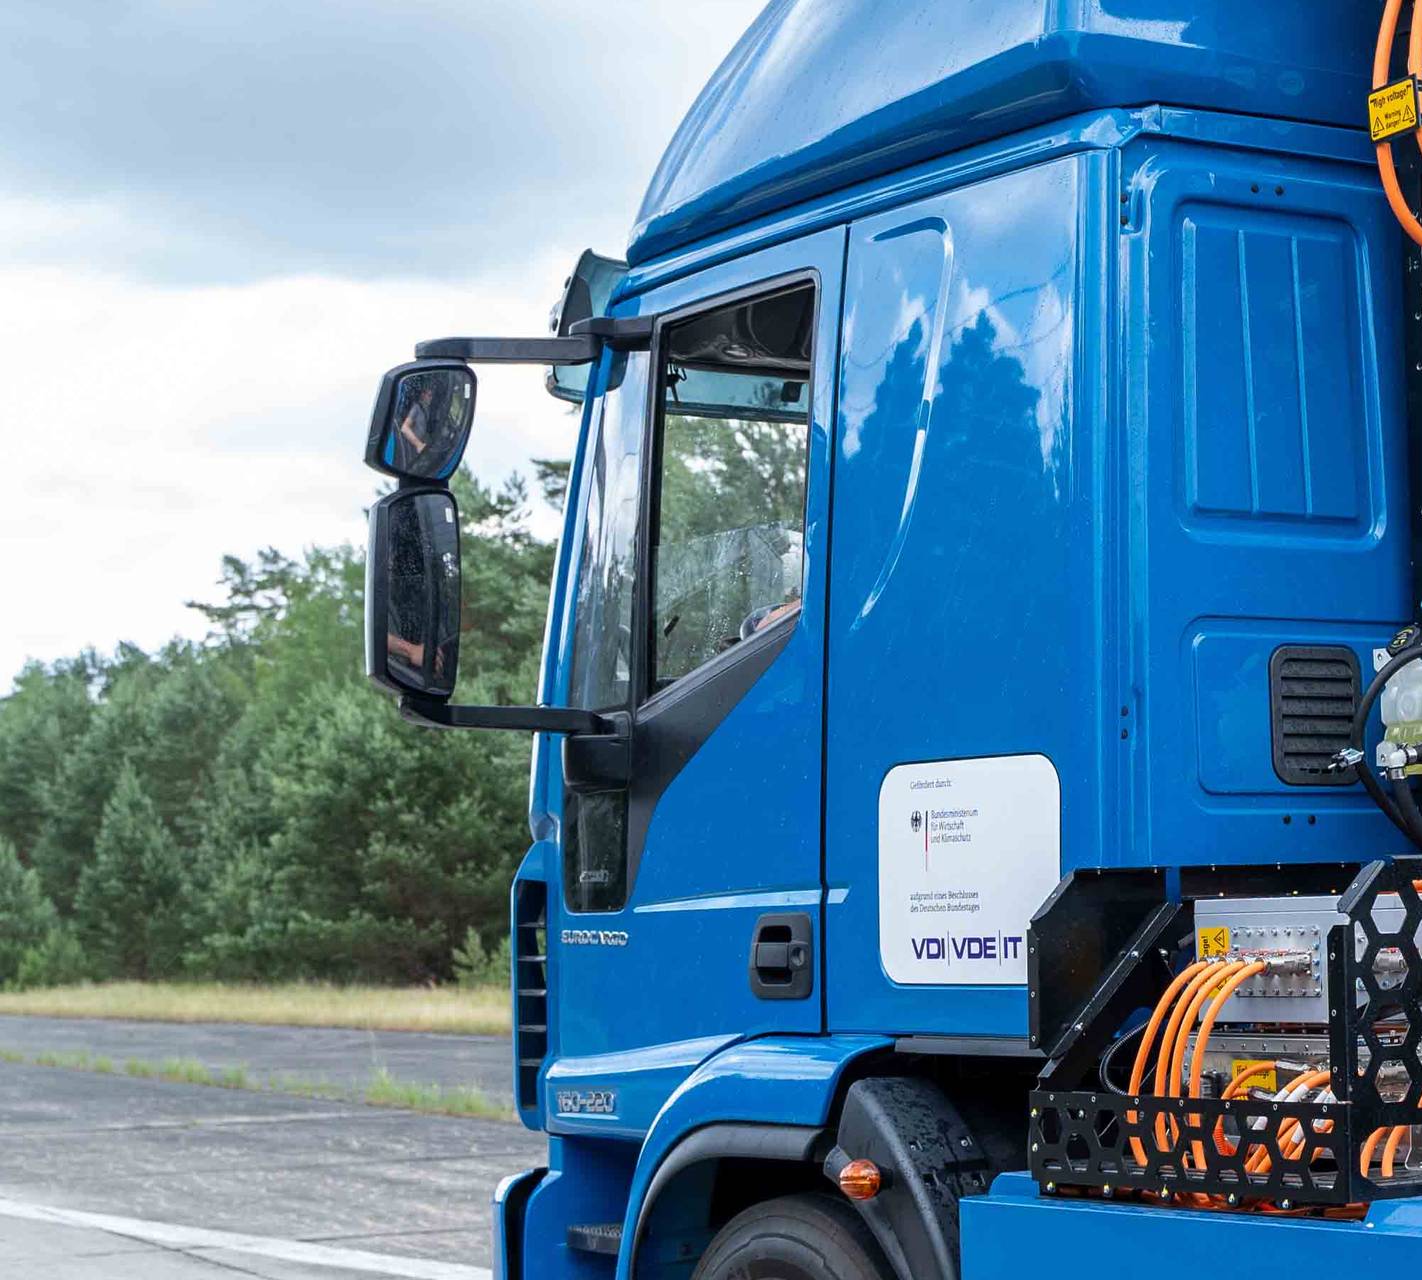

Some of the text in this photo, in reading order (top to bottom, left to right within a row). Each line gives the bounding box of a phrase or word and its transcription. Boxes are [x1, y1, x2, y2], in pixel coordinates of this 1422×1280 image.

[930, 809, 978, 819] Bundesministerium
[939, 819, 964, 830] Wirtschaft
[930, 832, 971, 843] und Klimaschutz
[910, 890, 979, 902] aufgrund eines Beschlusses
[910, 902, 980, 913] des Deutschen Bundestages
